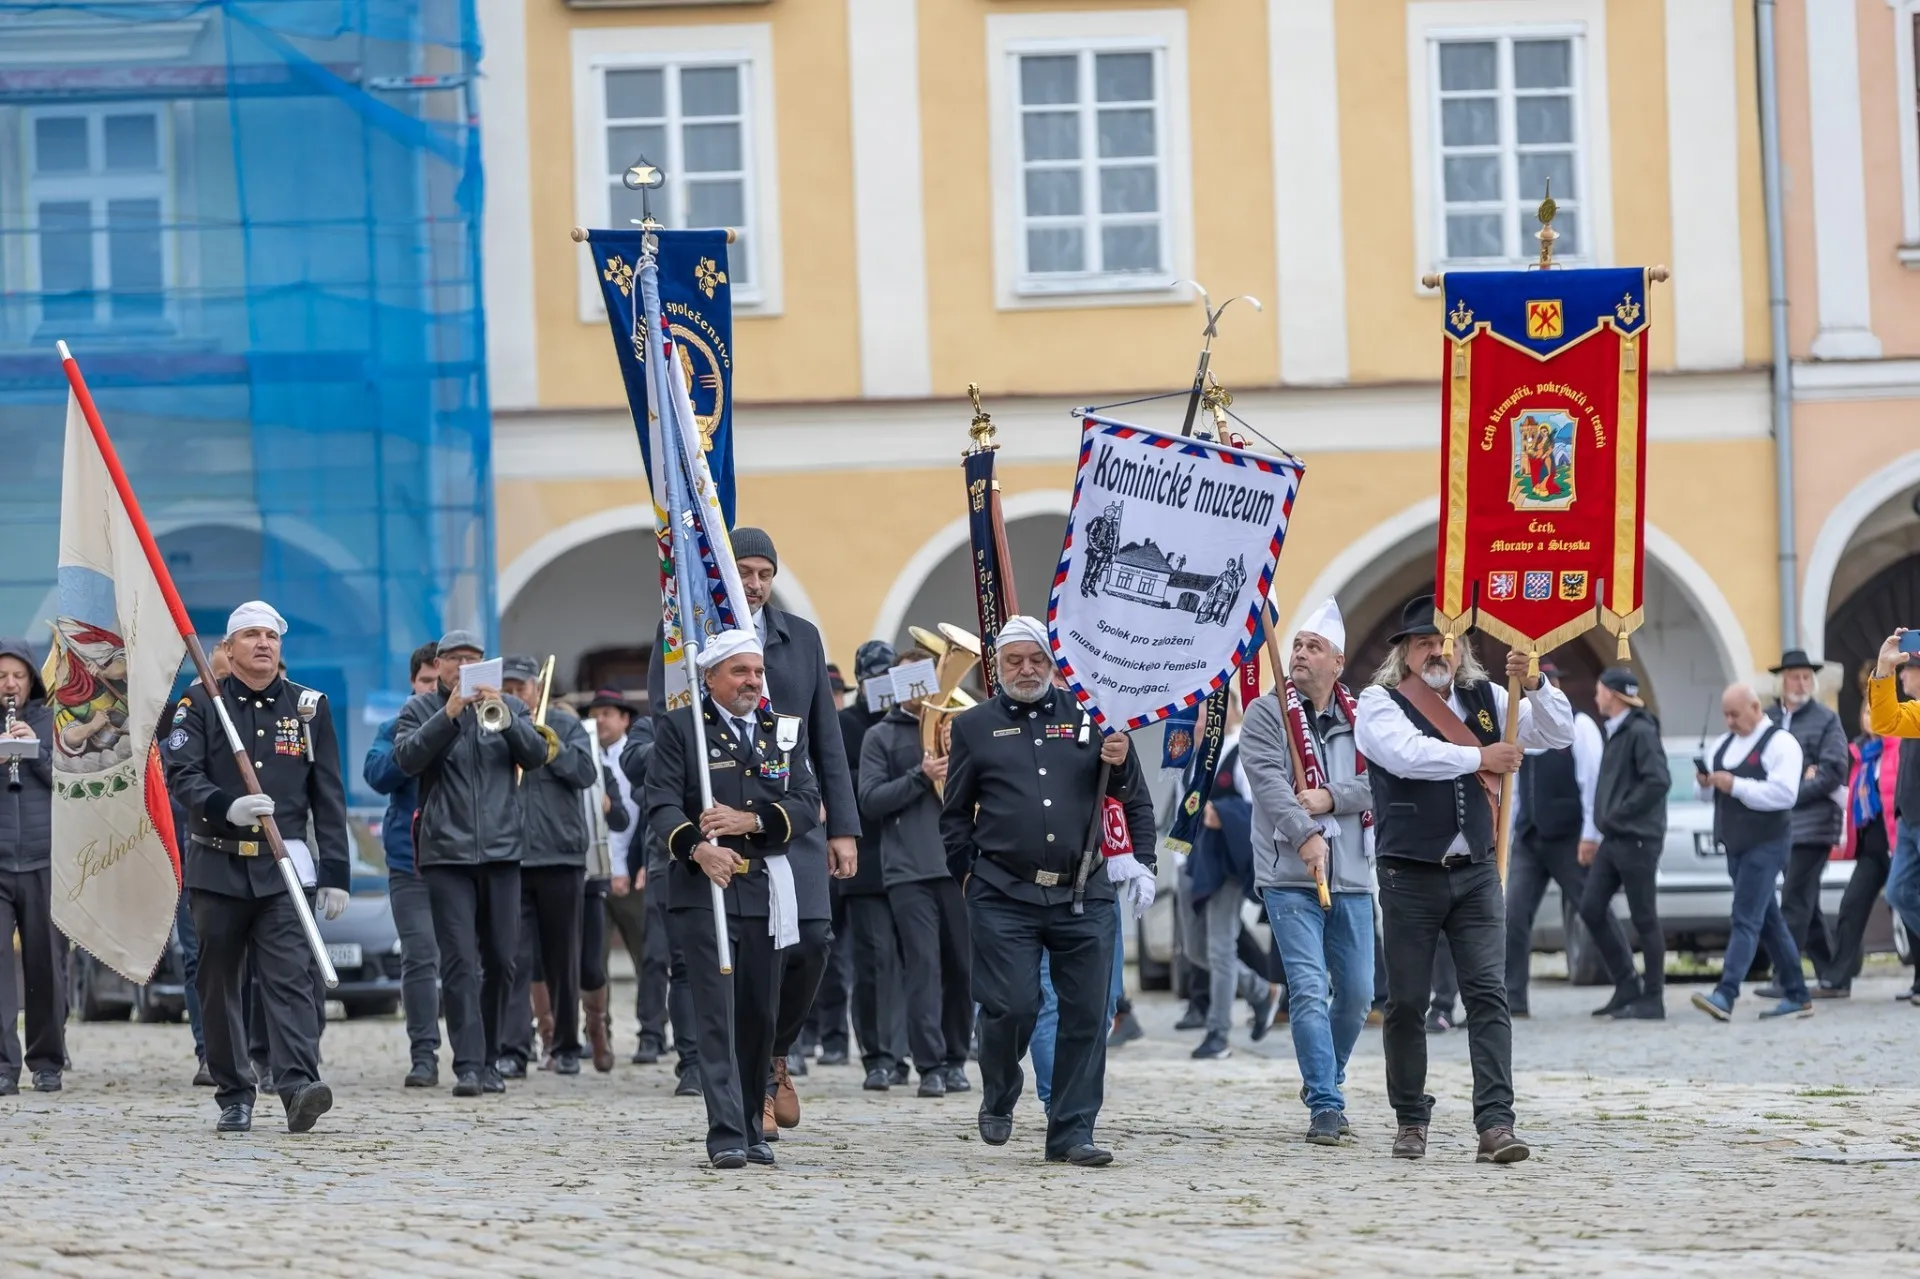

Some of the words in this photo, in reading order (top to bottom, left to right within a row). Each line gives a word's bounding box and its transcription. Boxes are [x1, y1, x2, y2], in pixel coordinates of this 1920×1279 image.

[666, 301, 730, 368] společenstvo
[1489, 384, 1534, 423] klempířů,
[1536, 381, 1588, 407] pokrývačů
[1584, 405, 1594, 414] a
[1093, 443, 1196, 509] Kominické
[1193, 476, 1275, 527] muzeum
[1490, 540, 1534, 553] Moravy
[1537, 542, 1544, 551] a
[1547, 539, 1591, 552] Slezska
[1528, 518, 1556, 533] Čech,
[1069, 629, 1101, 656] muzea
[1163, 659, 1207, 671] řemesla
[1096, 619, 1131, 640] Spolek
[1130, 634, 1150, 645] pro
[1151, 635, 1195, 646] založení
[1091, 671, 1099, 679] a
[1097, 673, 1118, 689] jeho
[1118, 682, 1170, 696] propgaci.
[1204, 693, 1216, 738] NÍKŮ
